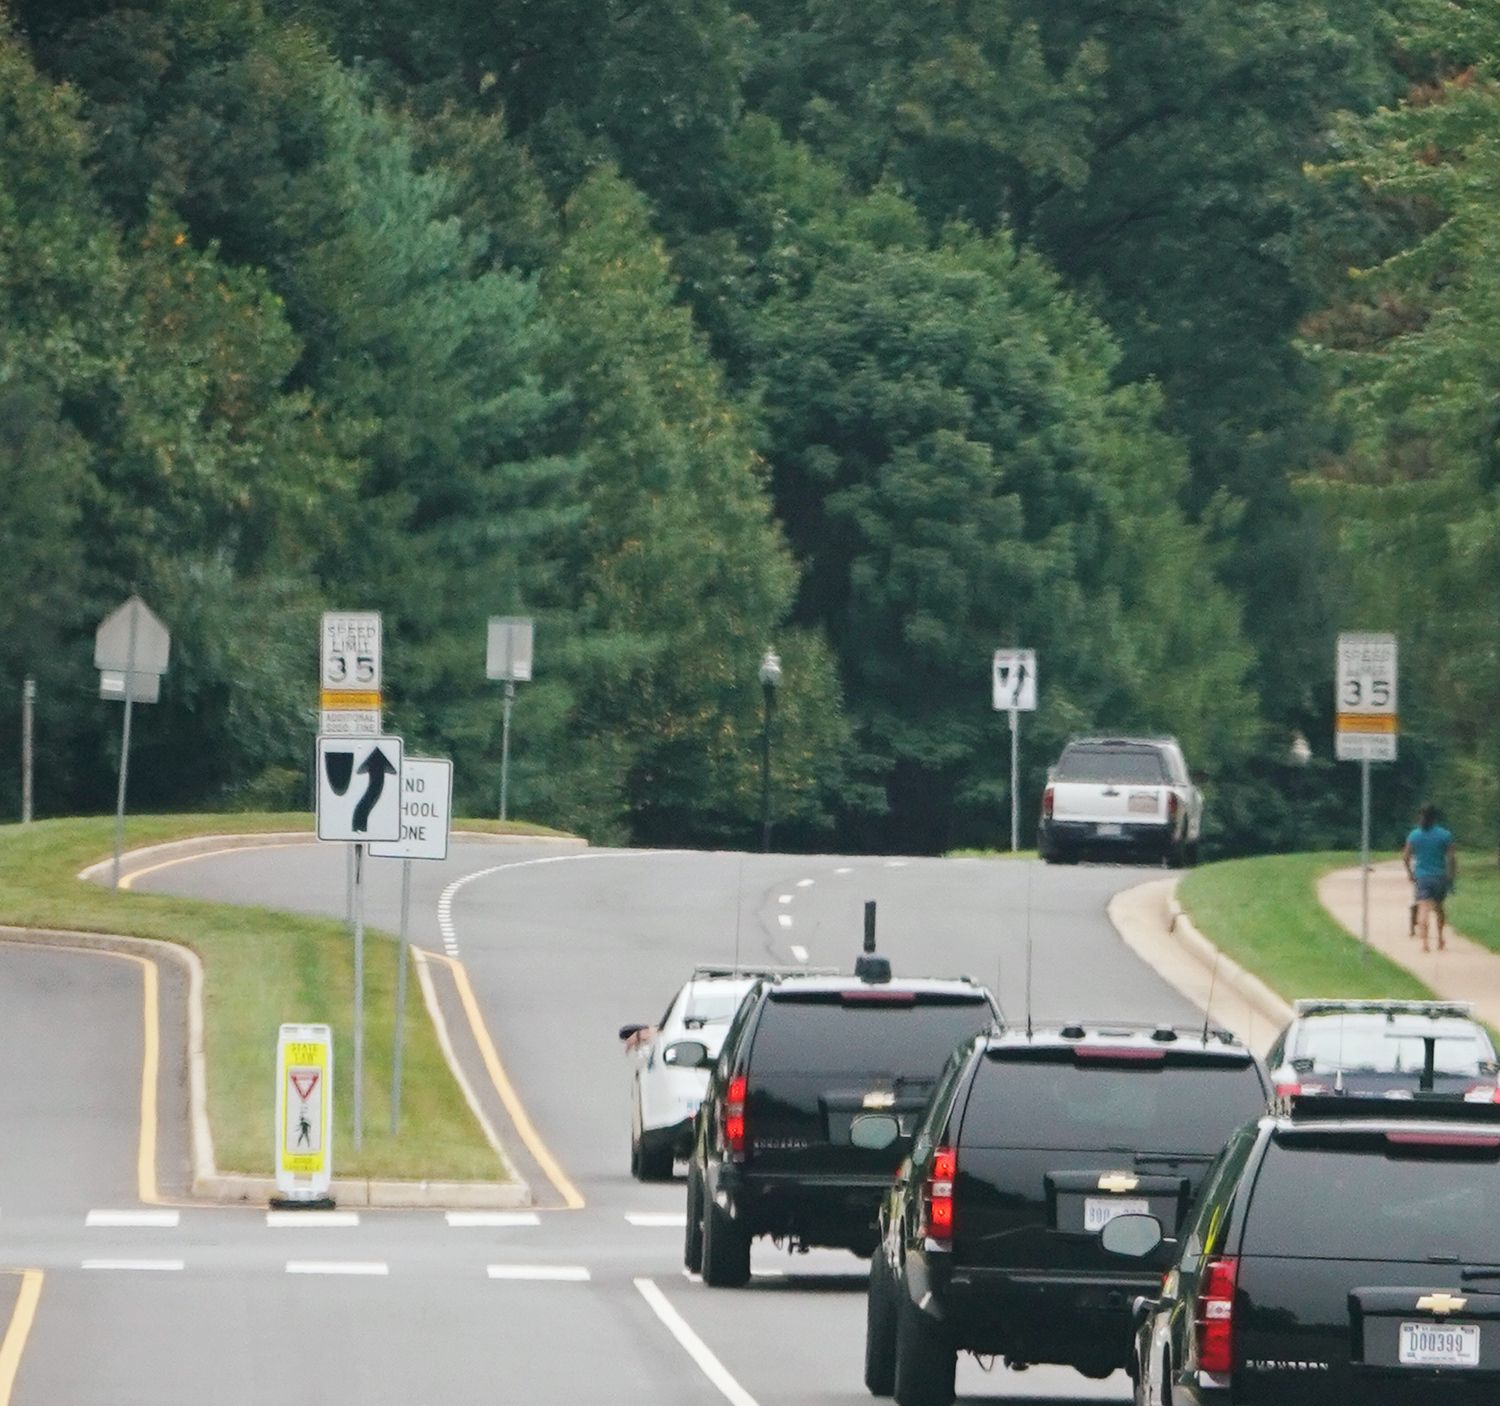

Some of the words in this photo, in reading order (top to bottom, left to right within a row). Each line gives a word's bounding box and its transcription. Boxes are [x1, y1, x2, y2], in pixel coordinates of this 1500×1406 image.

[328, 656, 375, 682] 35
[1343, 680, 1390, 706] 35
[402, 779, 425, 793] ND
[401, 802, 439, 818] HOOL
[402, 825, 426, 841] ONE
